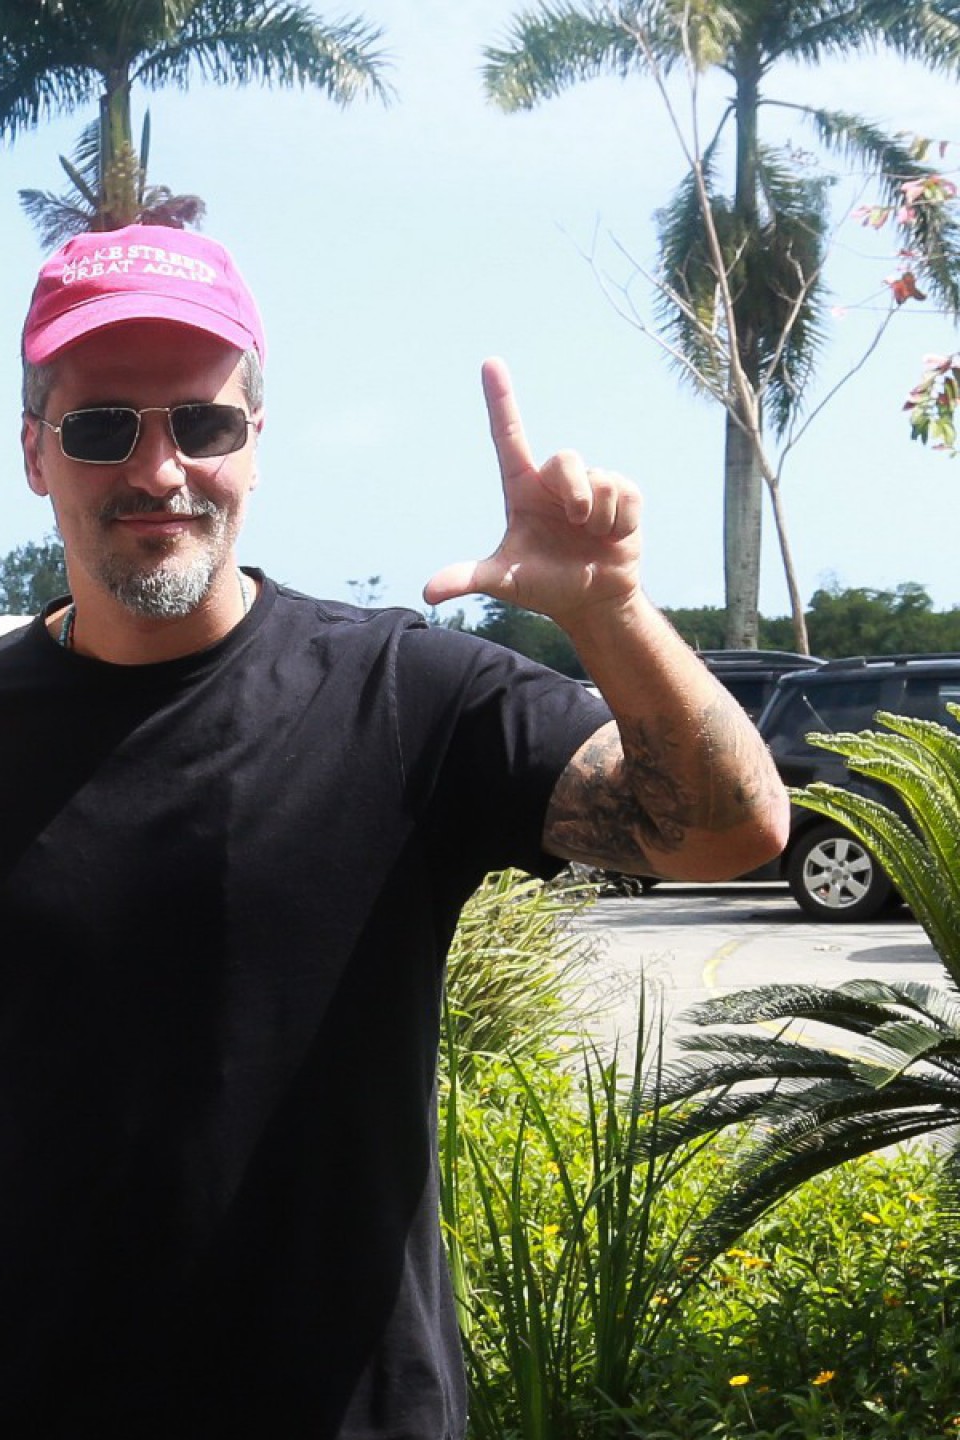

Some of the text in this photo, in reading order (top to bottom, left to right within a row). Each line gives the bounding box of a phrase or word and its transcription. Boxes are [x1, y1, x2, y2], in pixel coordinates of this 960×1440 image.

[62, 260, 213, 286] GREAT AGAIN
[63, 246, 123, 274] MAKE
